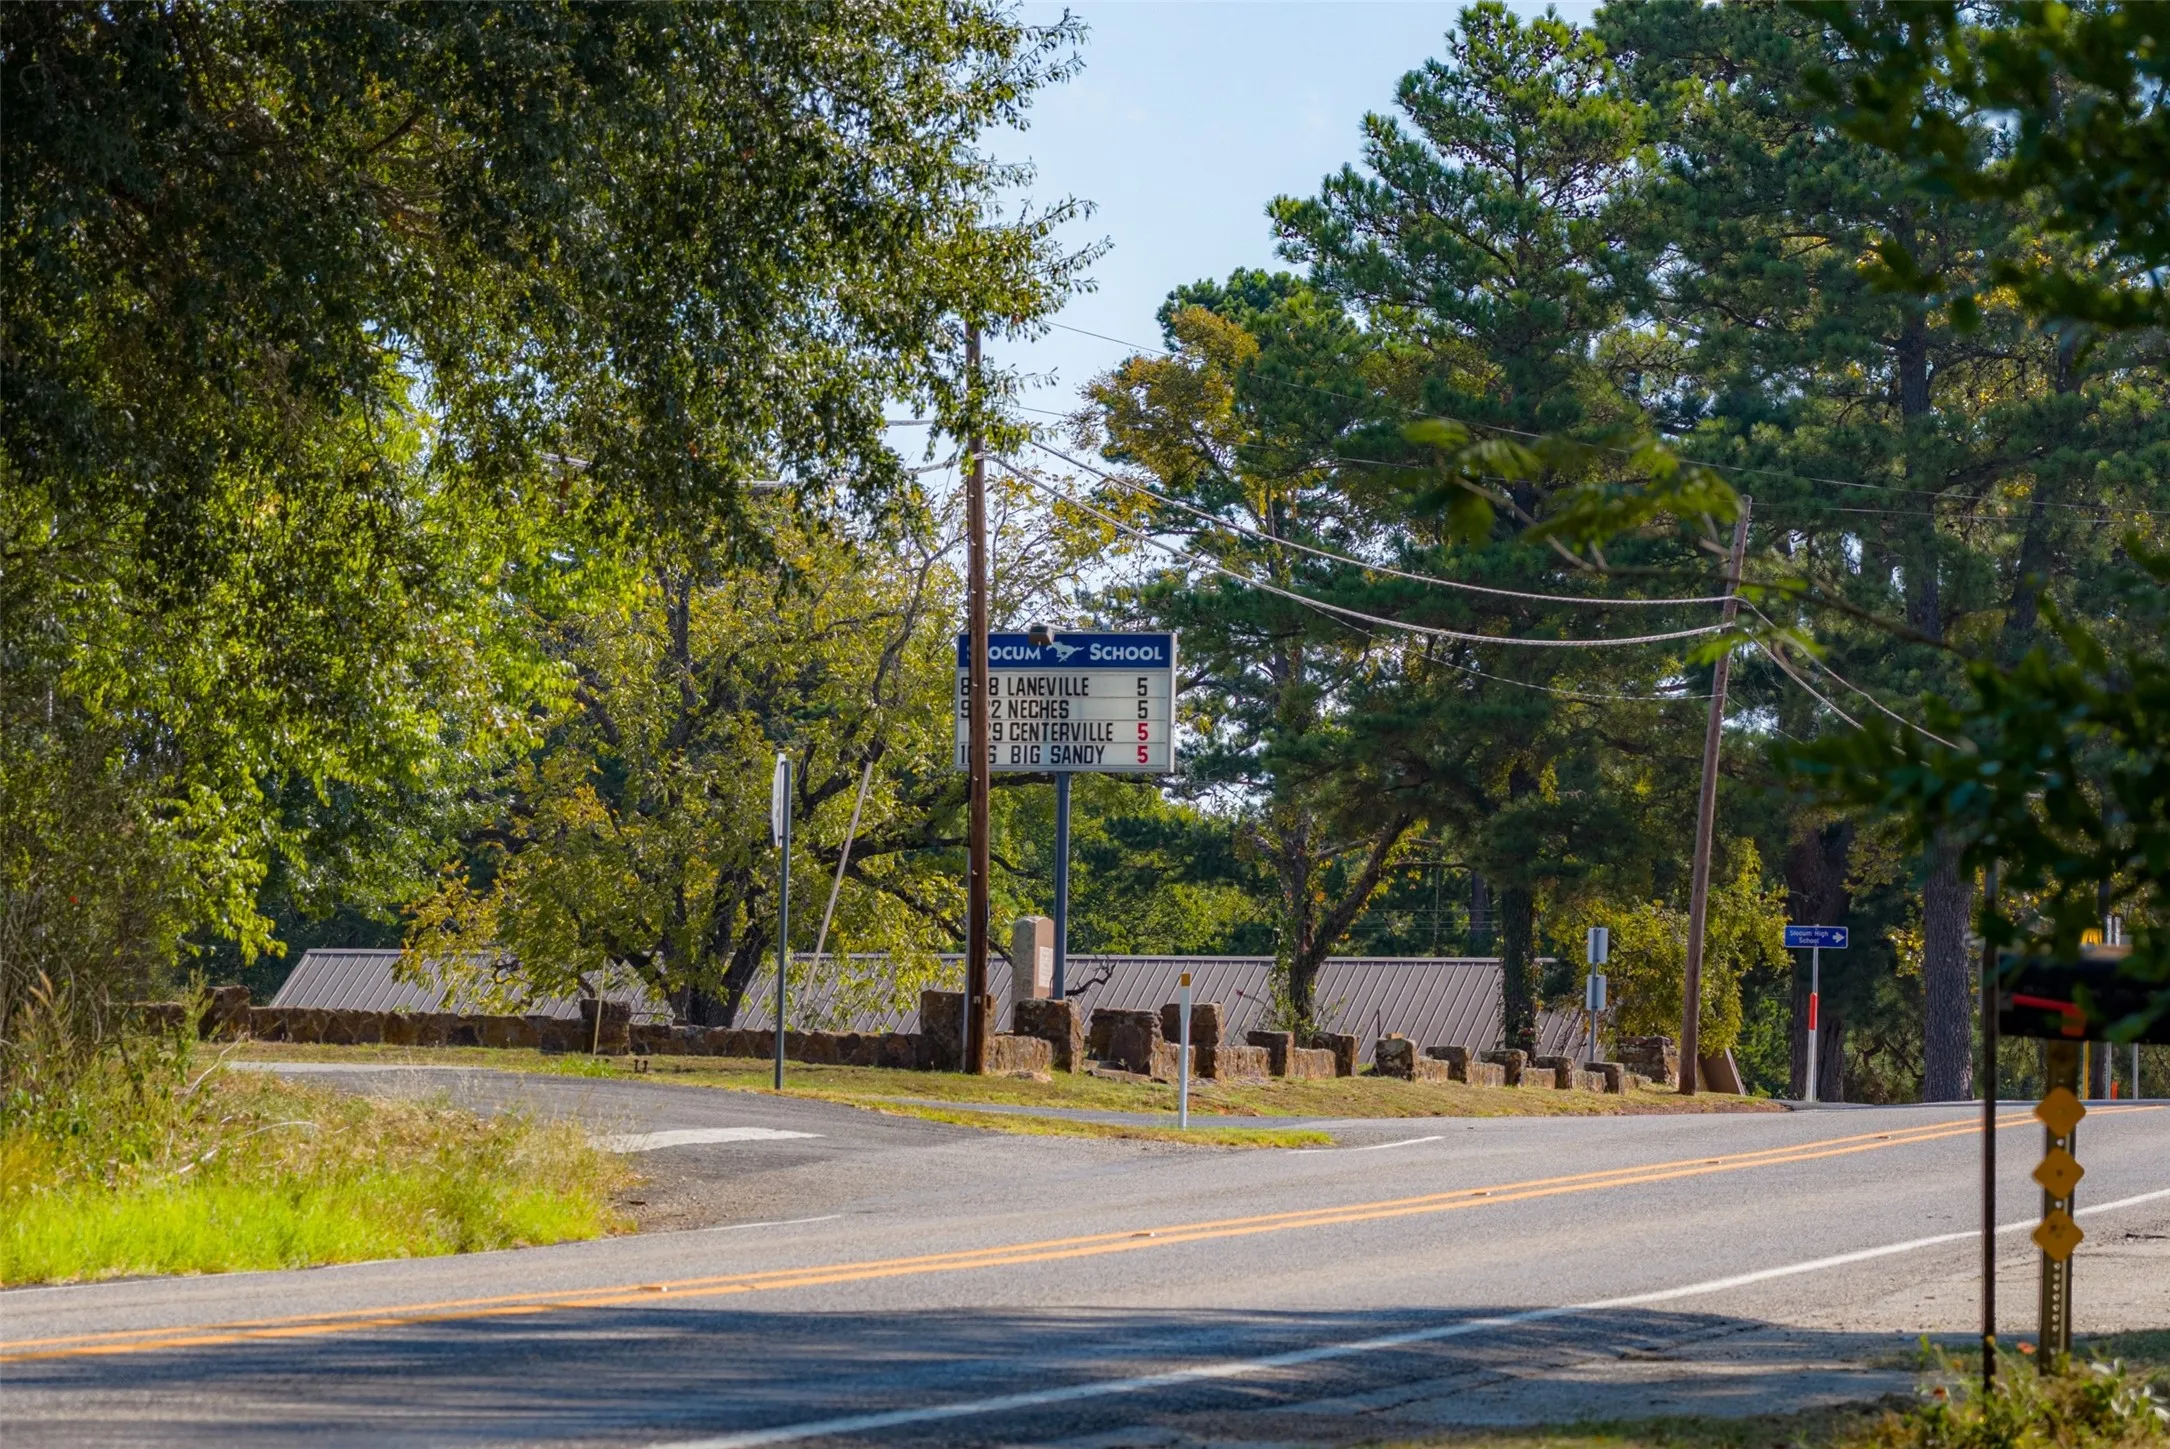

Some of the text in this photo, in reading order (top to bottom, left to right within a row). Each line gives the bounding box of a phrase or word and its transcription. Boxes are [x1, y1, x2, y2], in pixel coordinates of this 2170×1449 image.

[966, 643, 1163, 661] OCUM SCHOOL
[1008, 677, 1089, 696] LANEVILLE
[1137, 677, 1148, 697] 5
[1008, 700, 1069, 719] NECHES
[1137, 700, 1148, 719] 5
[1009, 722, 1113, 742] CENTERVILLE
[1137, 723, 1149, 741] 5
[1011, 745, 1040, 764] BIG
[1050, 745, 1105, 764] SANDY
[1137, 745, 1149, 764] 5
[1814, 930, 1829, 938] High
